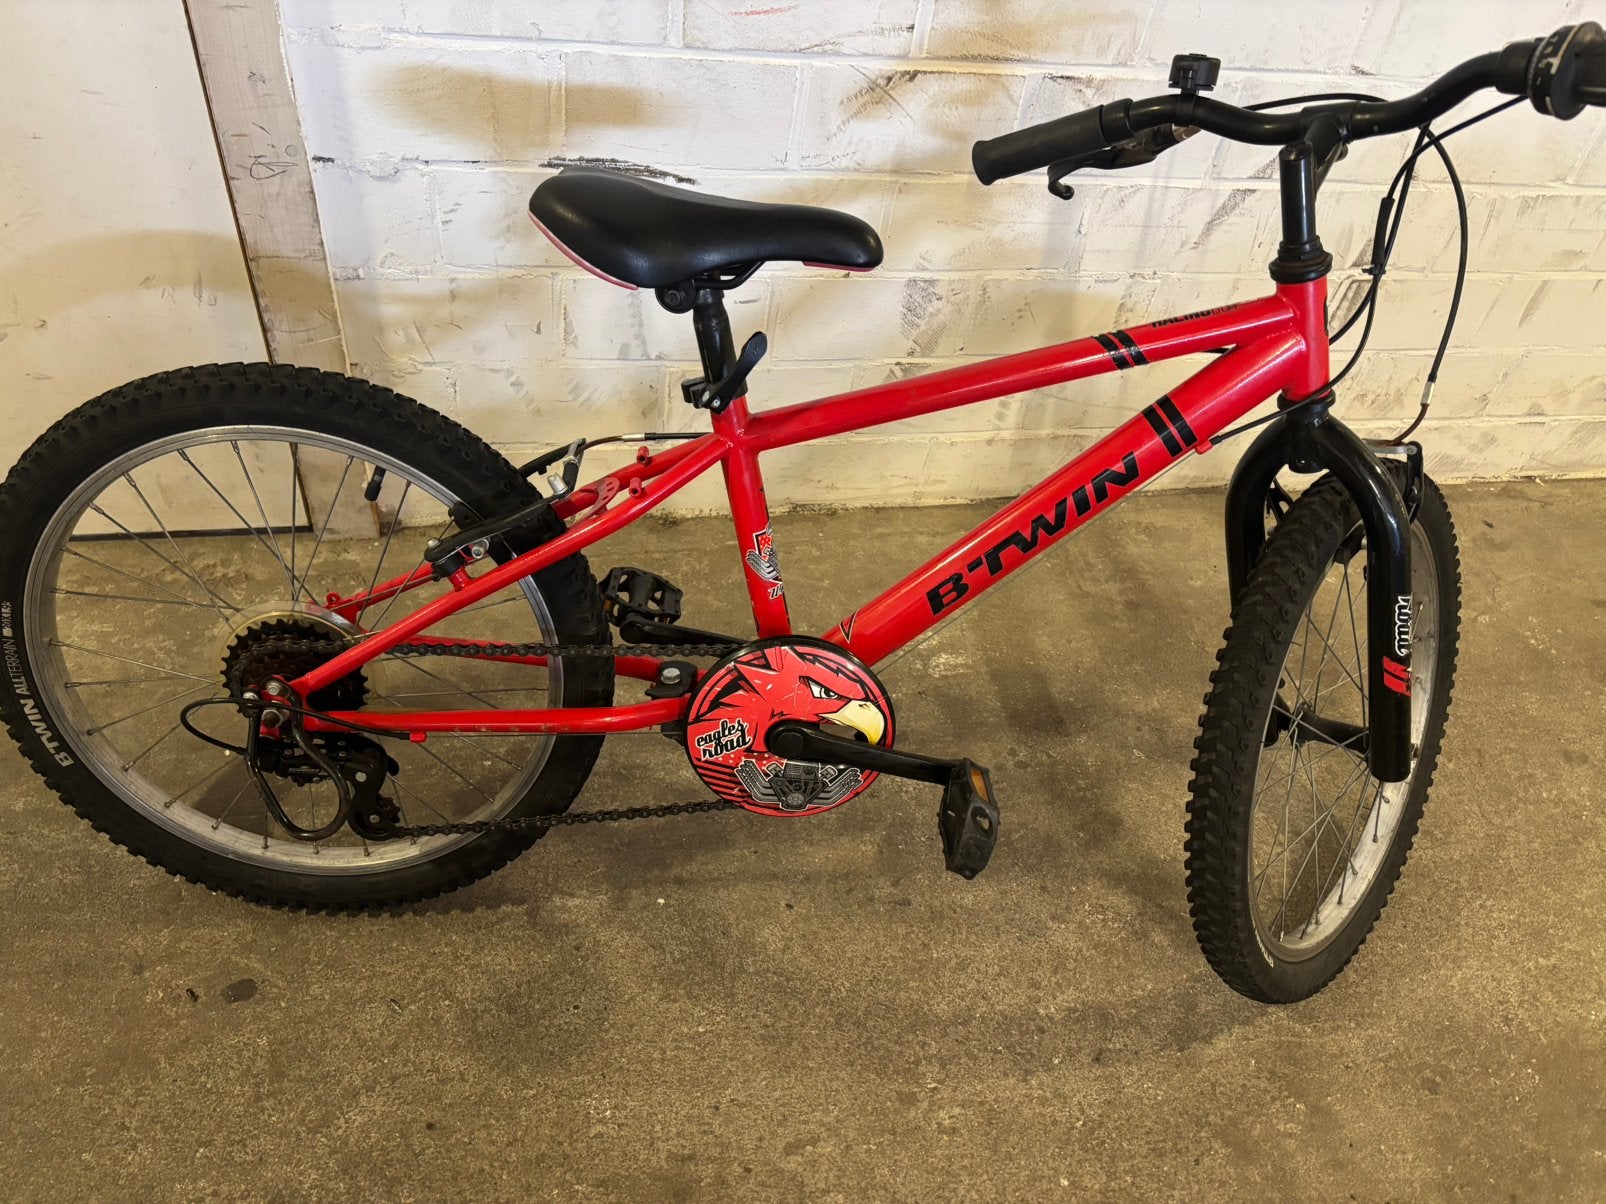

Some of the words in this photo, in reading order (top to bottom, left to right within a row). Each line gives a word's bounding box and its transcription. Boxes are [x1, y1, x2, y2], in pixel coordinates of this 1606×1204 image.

[926, 451, 1139, 616] B'TWIN
[19, 698, 75, 767] B'TWIN
[695, 717, 749, 749] eagles
[701, 734, 753, 760] road
